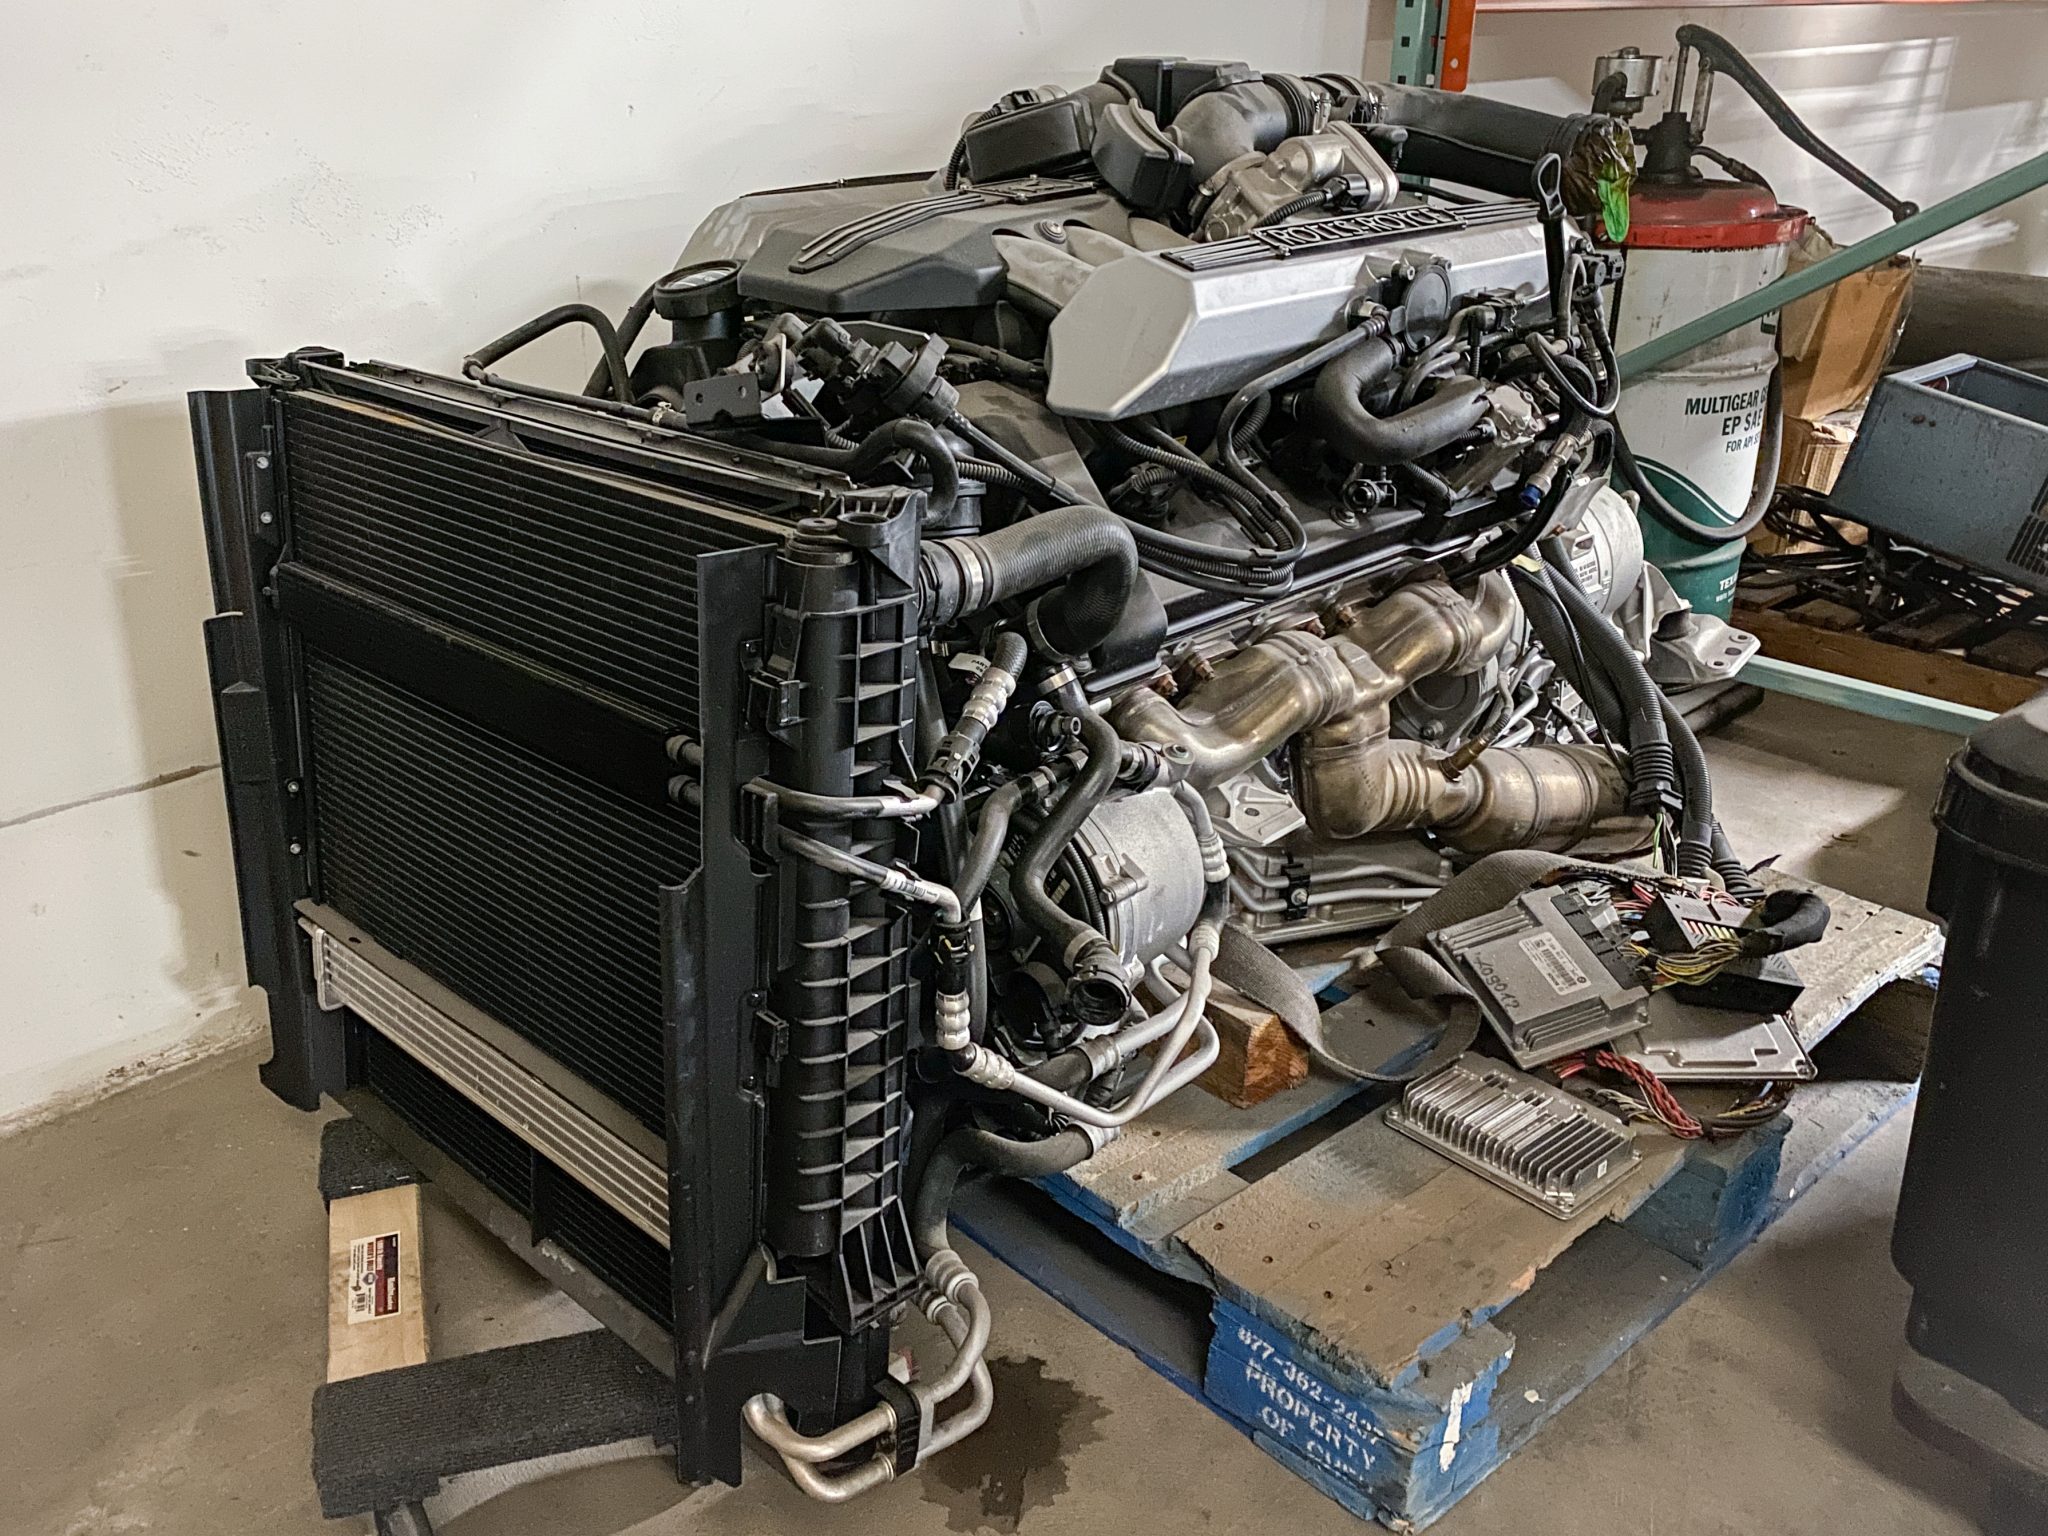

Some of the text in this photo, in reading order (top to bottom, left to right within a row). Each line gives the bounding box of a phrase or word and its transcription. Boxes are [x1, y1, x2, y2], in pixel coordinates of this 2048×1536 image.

[1685, 389, 1759, 415] MULTIGEAR
[1721, 416, 1741, 436] EP
[1726, 439, 1741, 453] FOR
[1246, 1358, 1376, 1471] PROPERTY
[1260, 1406, 1296, 1437] OF
